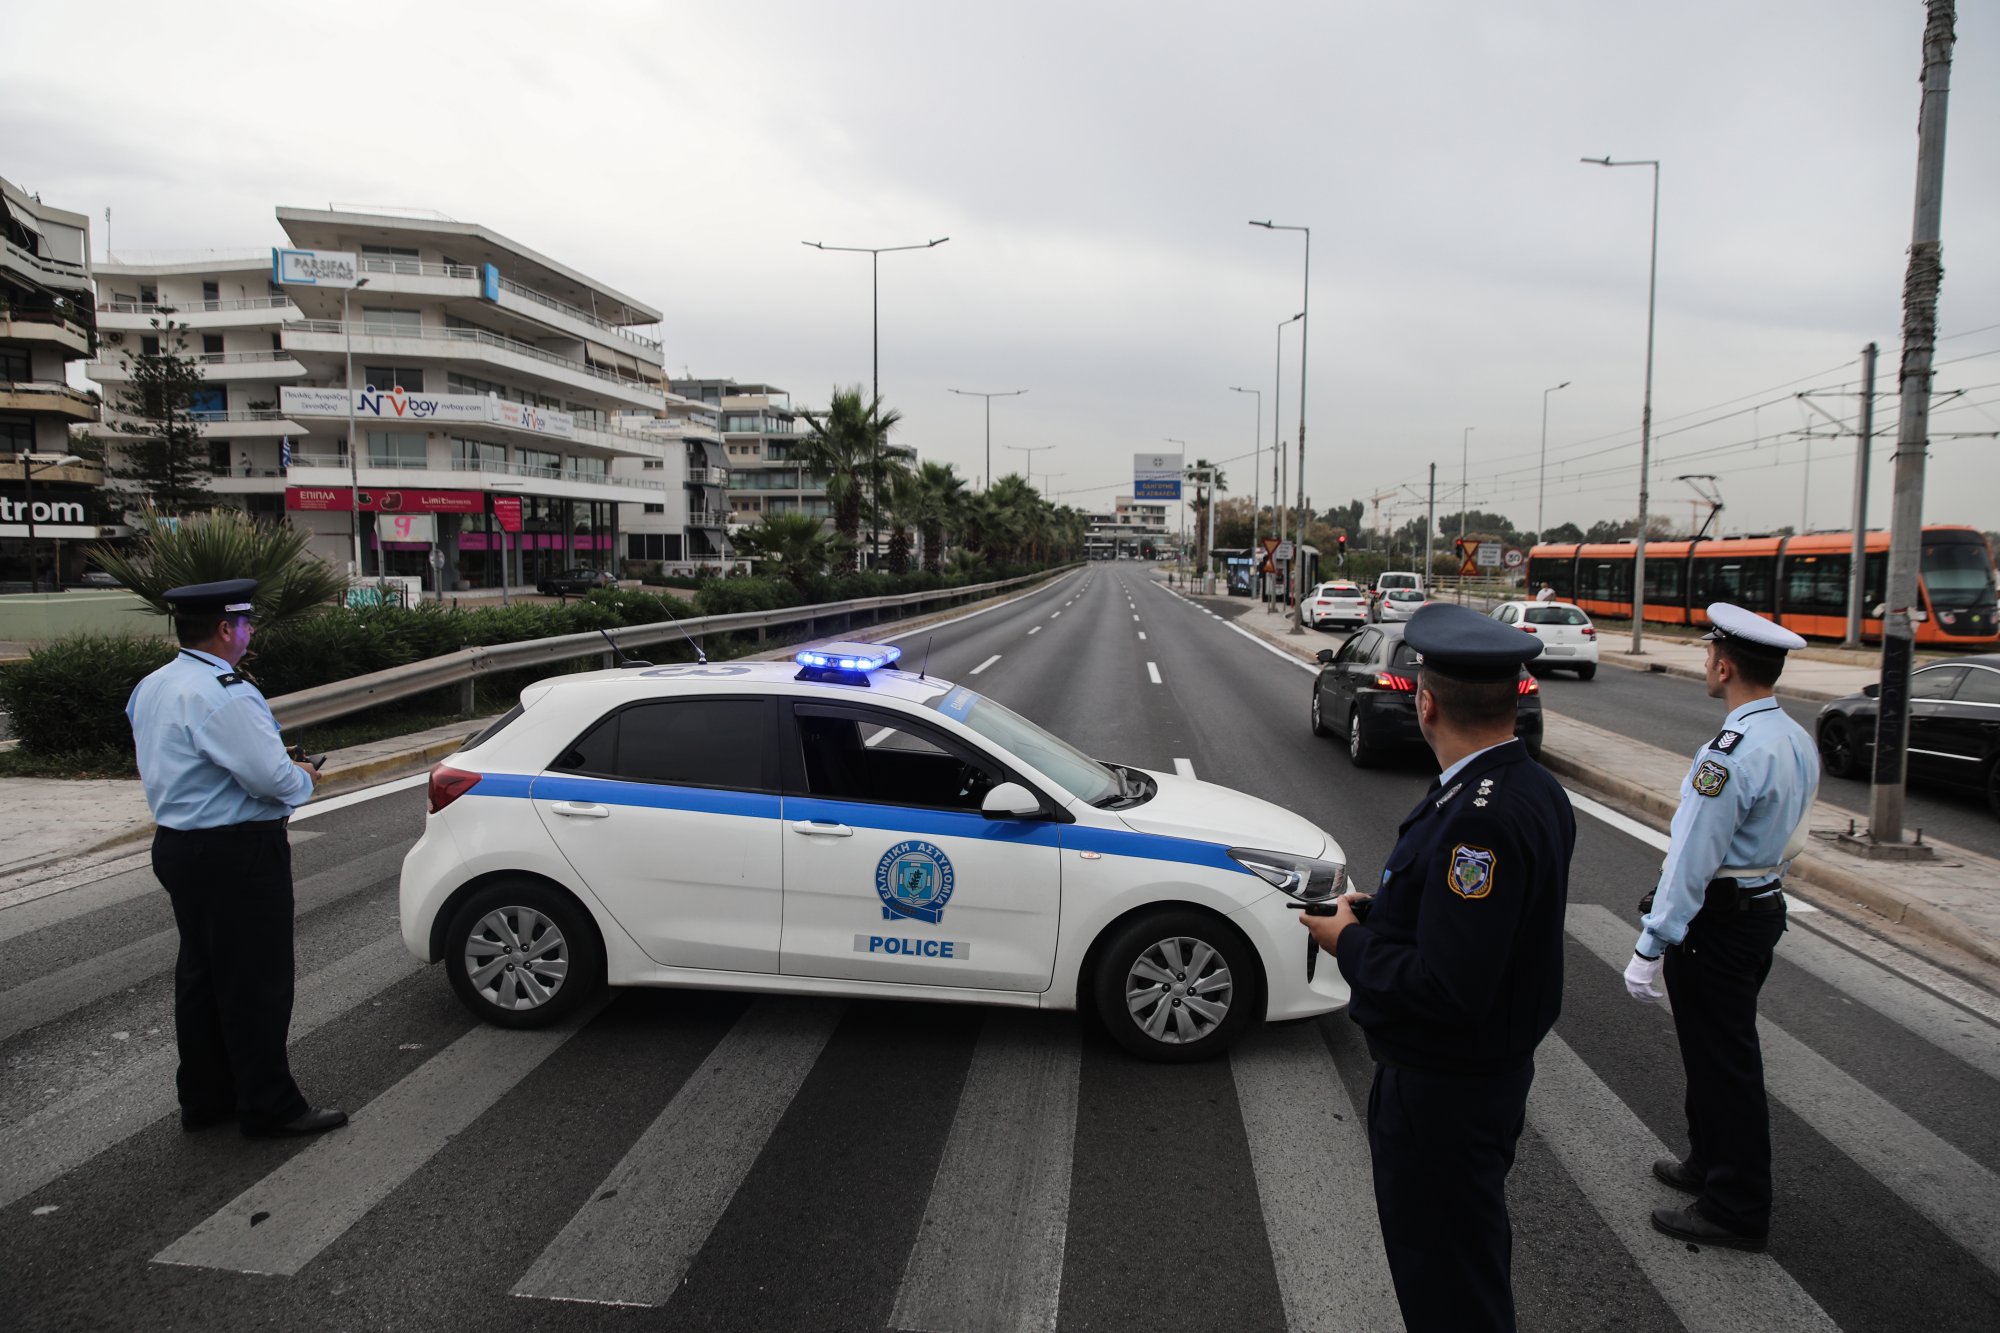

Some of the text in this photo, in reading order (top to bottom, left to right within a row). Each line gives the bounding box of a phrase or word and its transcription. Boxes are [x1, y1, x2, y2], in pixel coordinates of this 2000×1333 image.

[294, 258, 354, 273] PARSIFAL
[303, 269, 354, 281] YACHTING
[441, 402, 482, 412] nvbay.com
[300, 490, 336, 501] ΕΠΙΠΛΑ
[1508, 554, 1521, 563] 30
[878, 842, 952, 904] ΕΛΛΗΝΙΚΗ ΑΣΤΥΝΟΜΙΑ
[869, 936, 954, 958] POLICE
